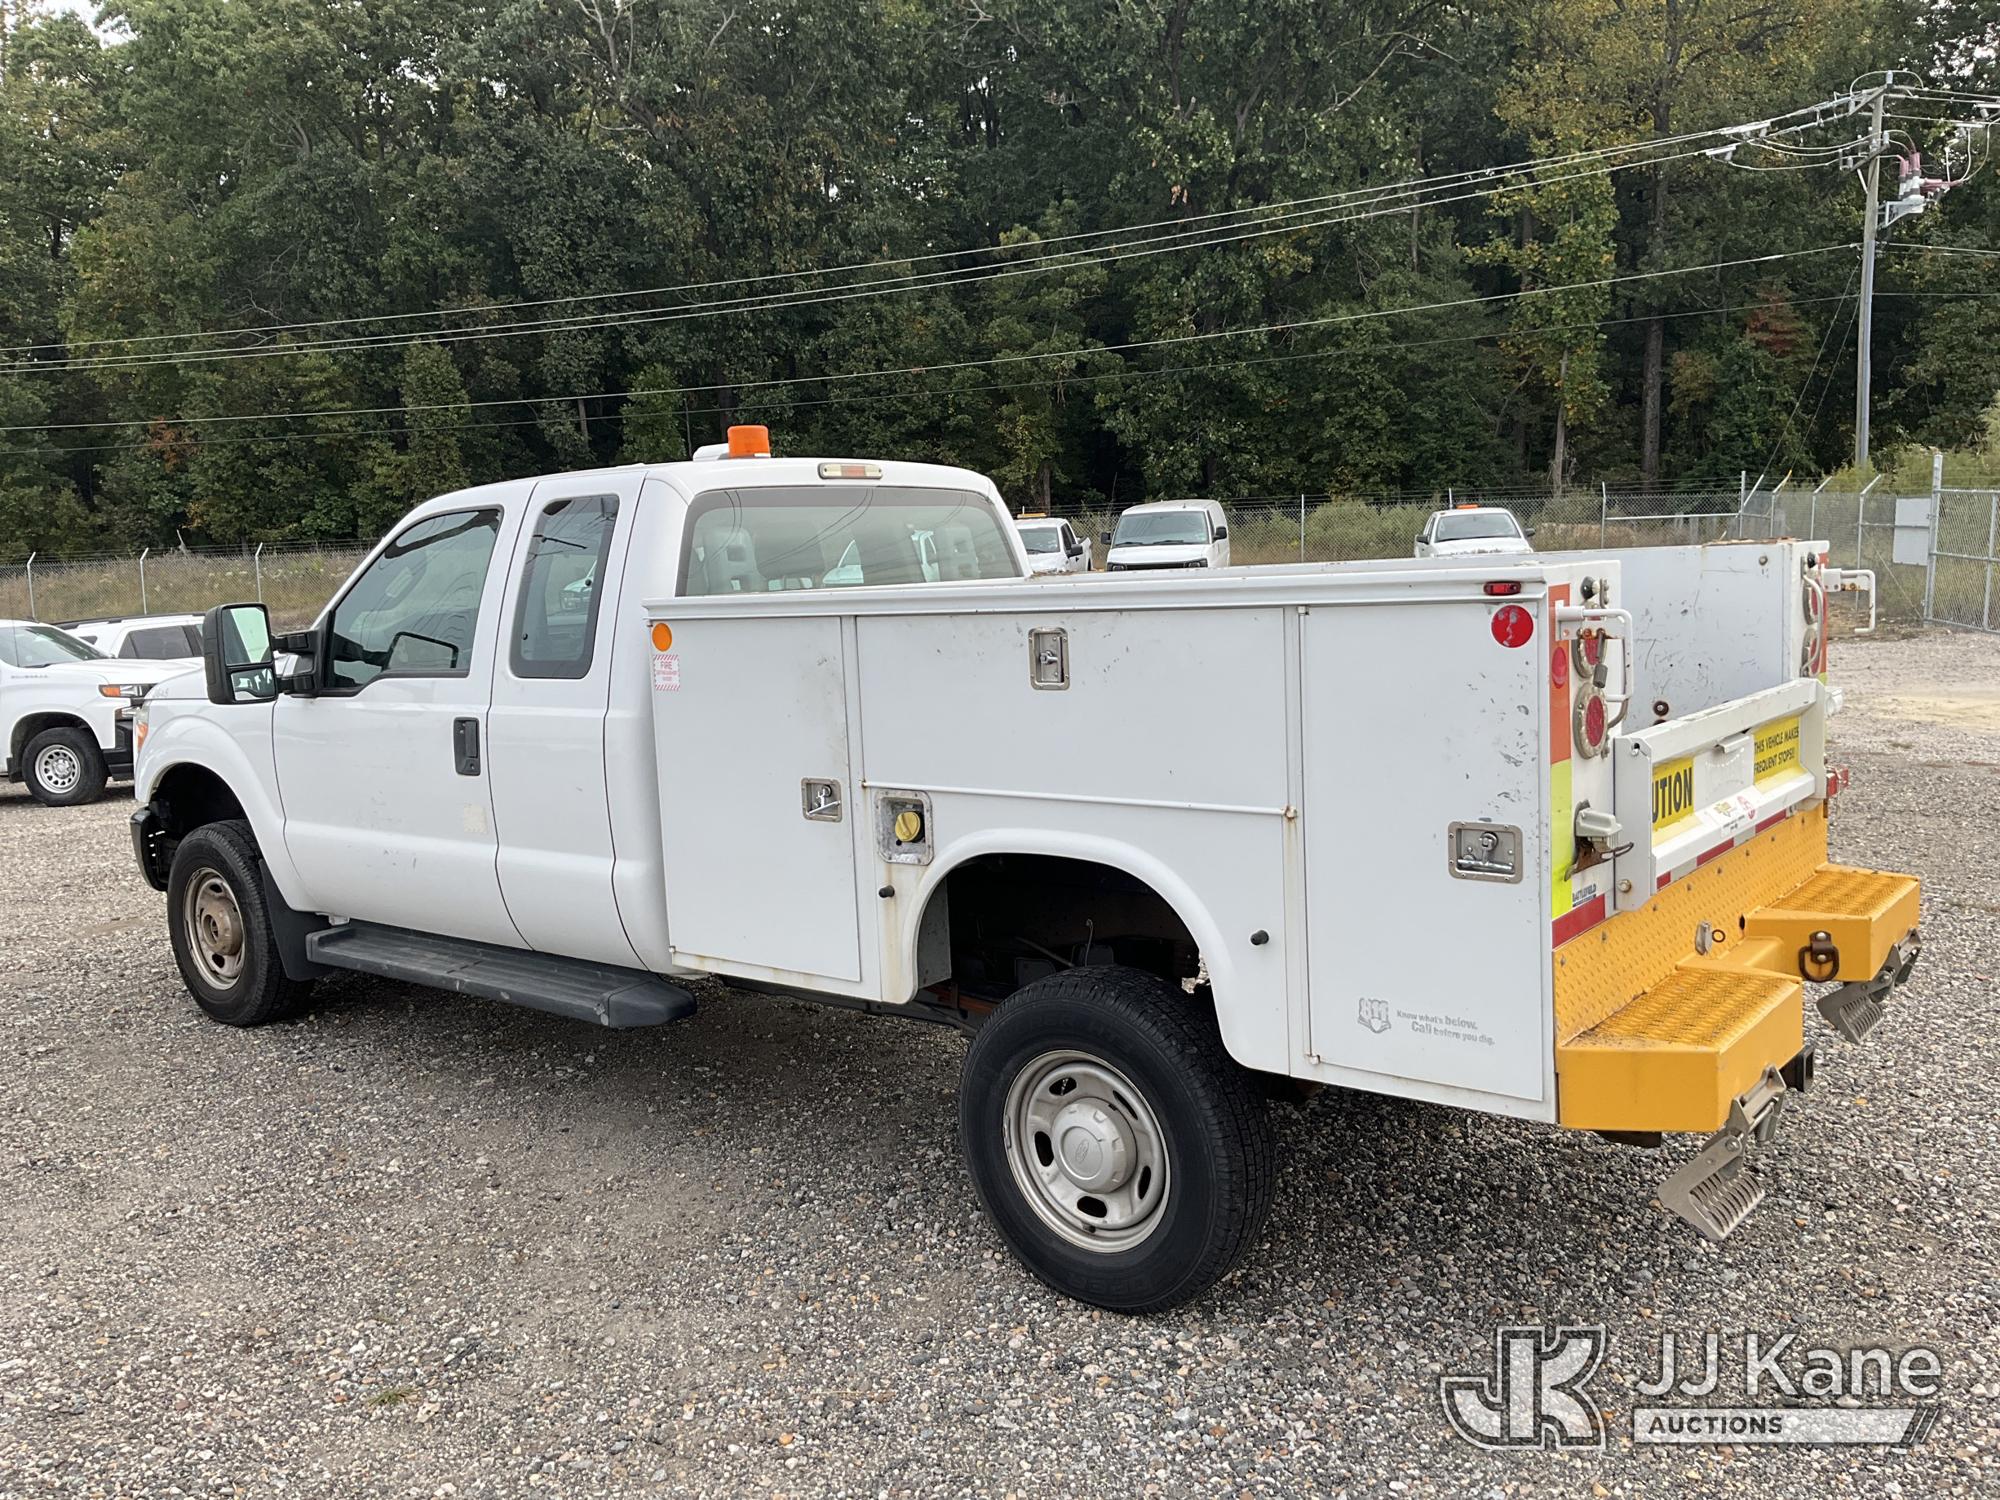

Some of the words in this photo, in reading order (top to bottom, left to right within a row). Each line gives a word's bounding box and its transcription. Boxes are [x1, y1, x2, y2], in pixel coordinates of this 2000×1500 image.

[1754, 740, 1764, 754] THIS
[1765, 732, 1783, 749] VEHICLE
[1754, 754, 1777, 776] FREQUENT
[1397, 1010, 1417, 1020] Know
[1444, 1016, 1478, 1030] below.
[1411, 1021, 1432, 1034] Call
[1433, 1027, 1461, 1039] before
[1462, 1033, 1478, 1042] you
[1479, 1034, 1496, 1046] dig.
